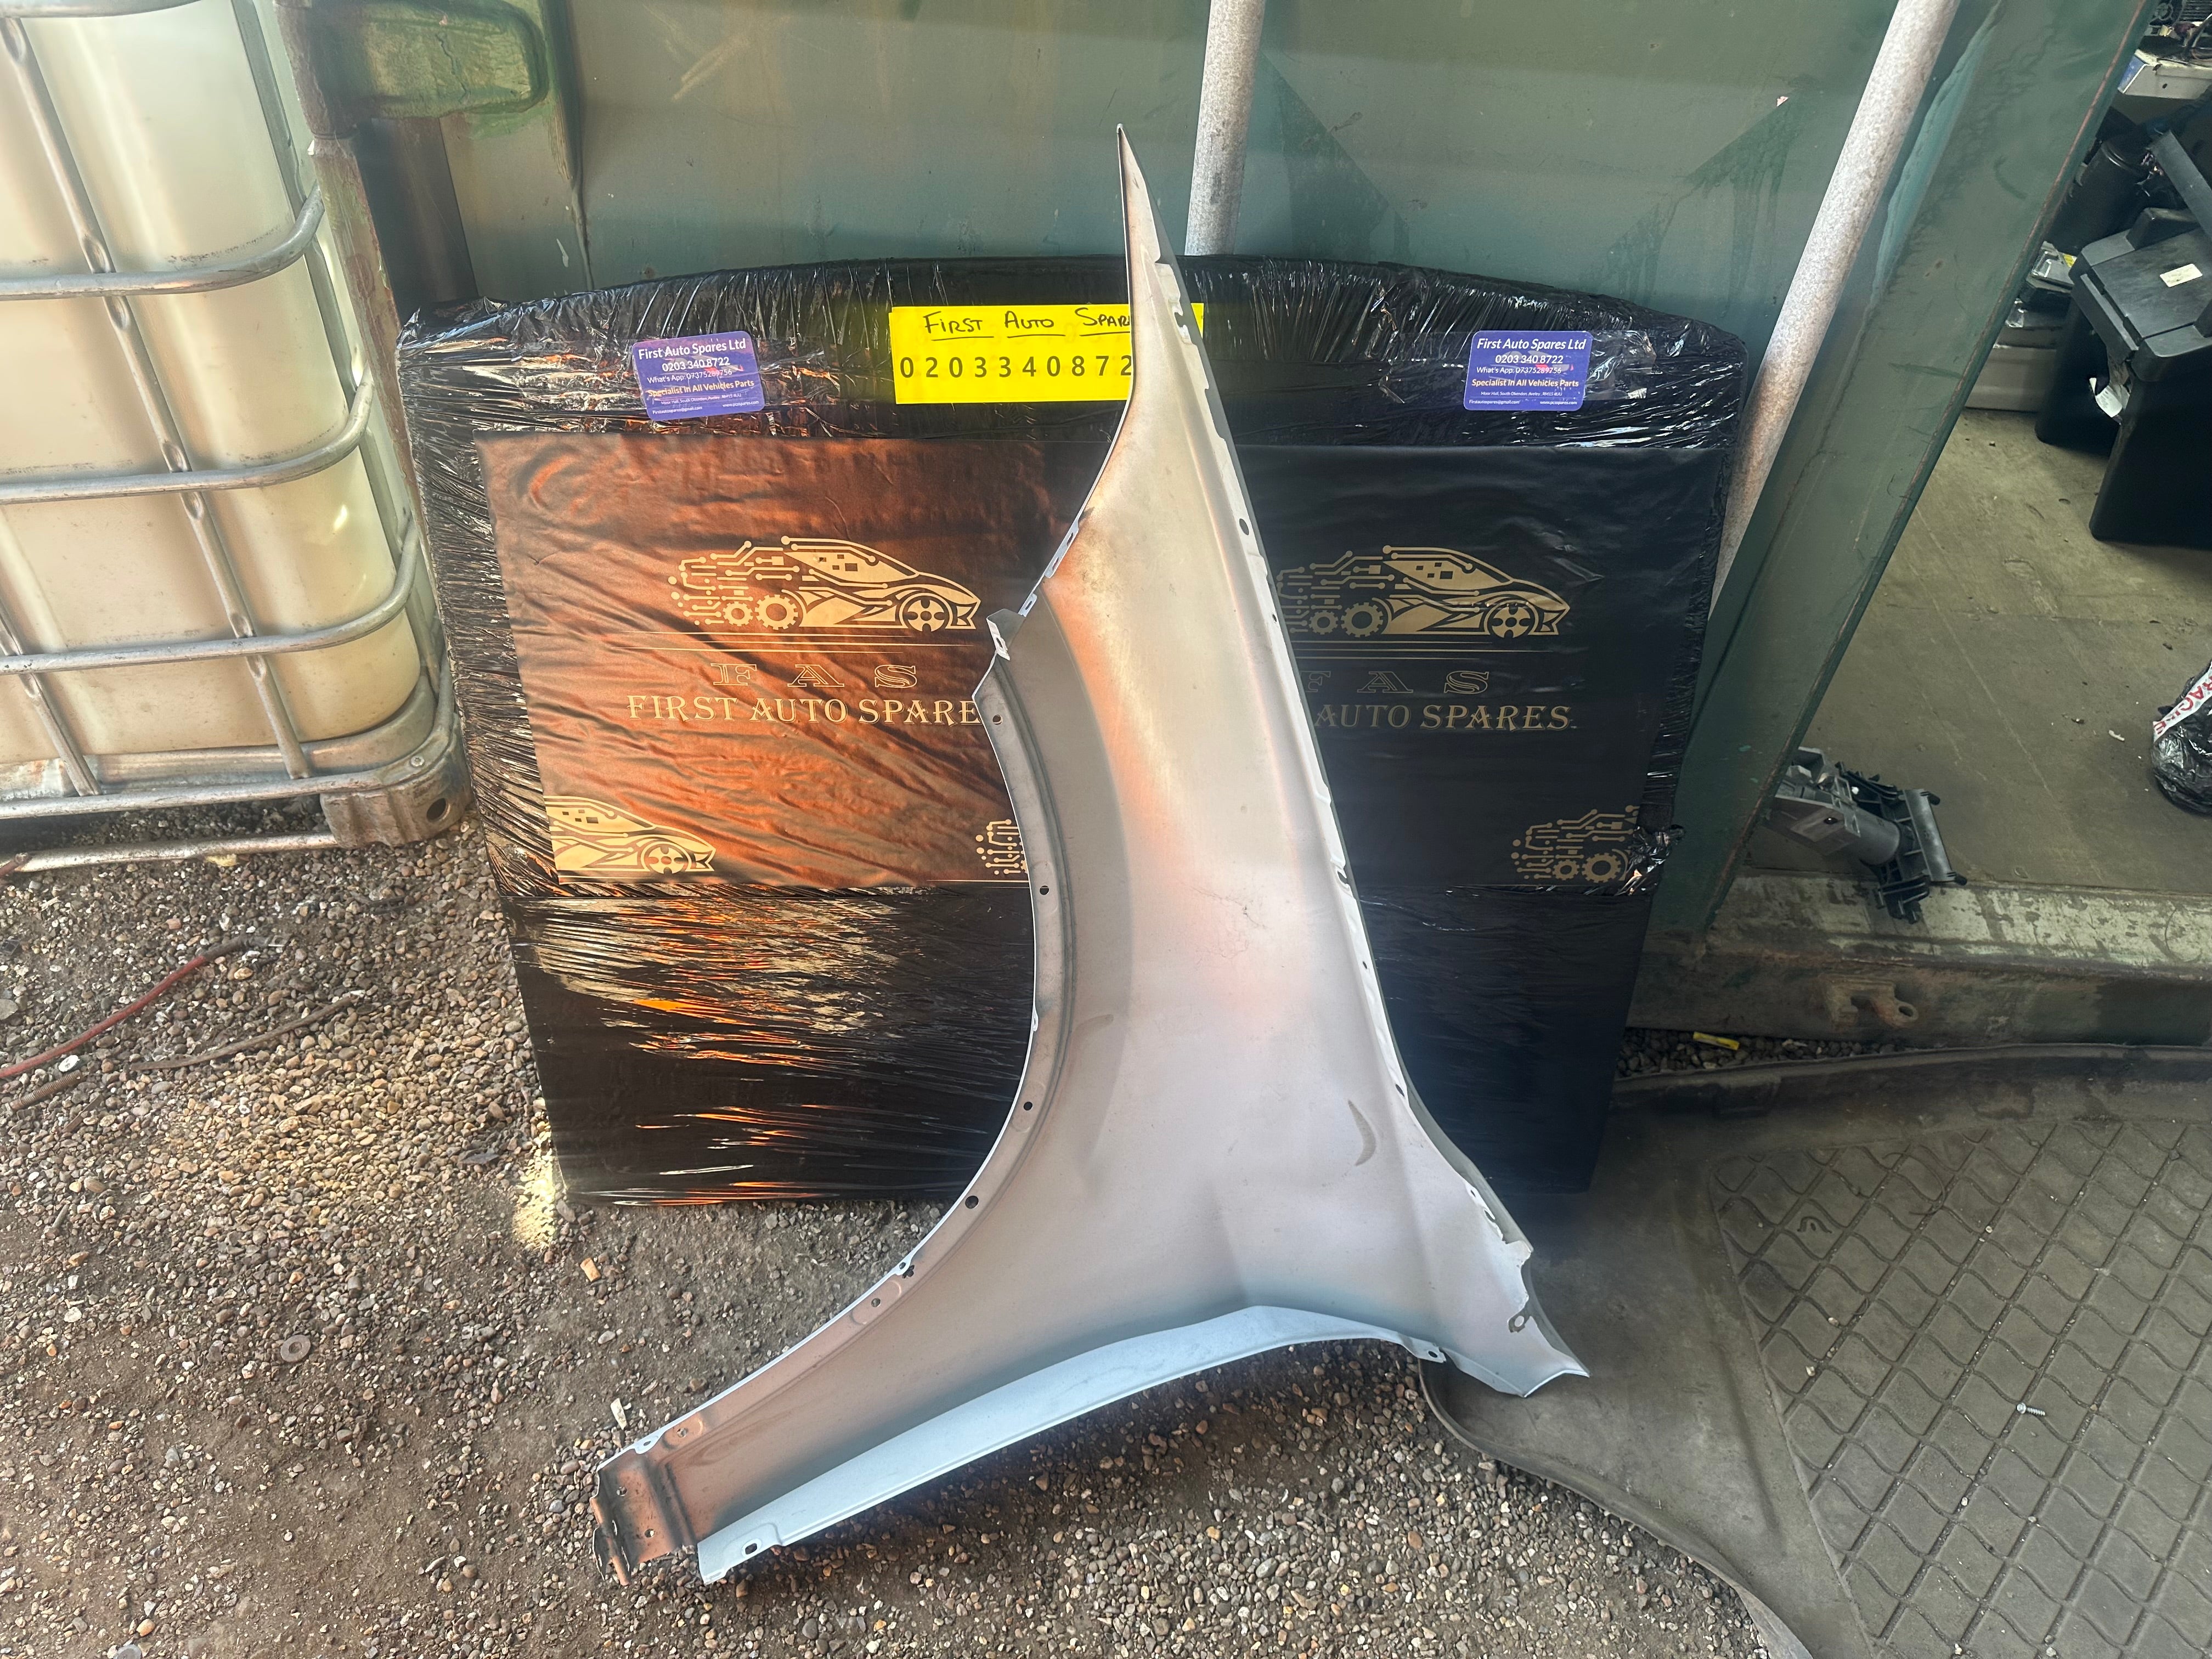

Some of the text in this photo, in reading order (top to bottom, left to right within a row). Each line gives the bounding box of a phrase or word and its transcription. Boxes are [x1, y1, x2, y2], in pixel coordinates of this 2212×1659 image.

[1005, 311, 1054, 329] AUTO
[1074, 307, 1130, 328] SPAR
[638, 338, 746, 360] First Auto Spares Ltd
[1477, 338, 1587, 351] First Auto Spares Ltd
[662, 357, 731, 372] 0203 340 8722
[900, 355, 1132, 378] 0203340872
[1495, 354, 1564, 364] 0203 340 8722
[648, 386, 682, 397] Specialist
[692, 384, 702, 392] All
[703, 381, 734, 391] Vehicles
[735, 380, 755, 388] Parts
[1471, 379, 1506, 387] Specialist
[627, 695, 983, 727] FIRST AUTO SPARE
[1314, 704, 1572, 731] AUTO SPARES
